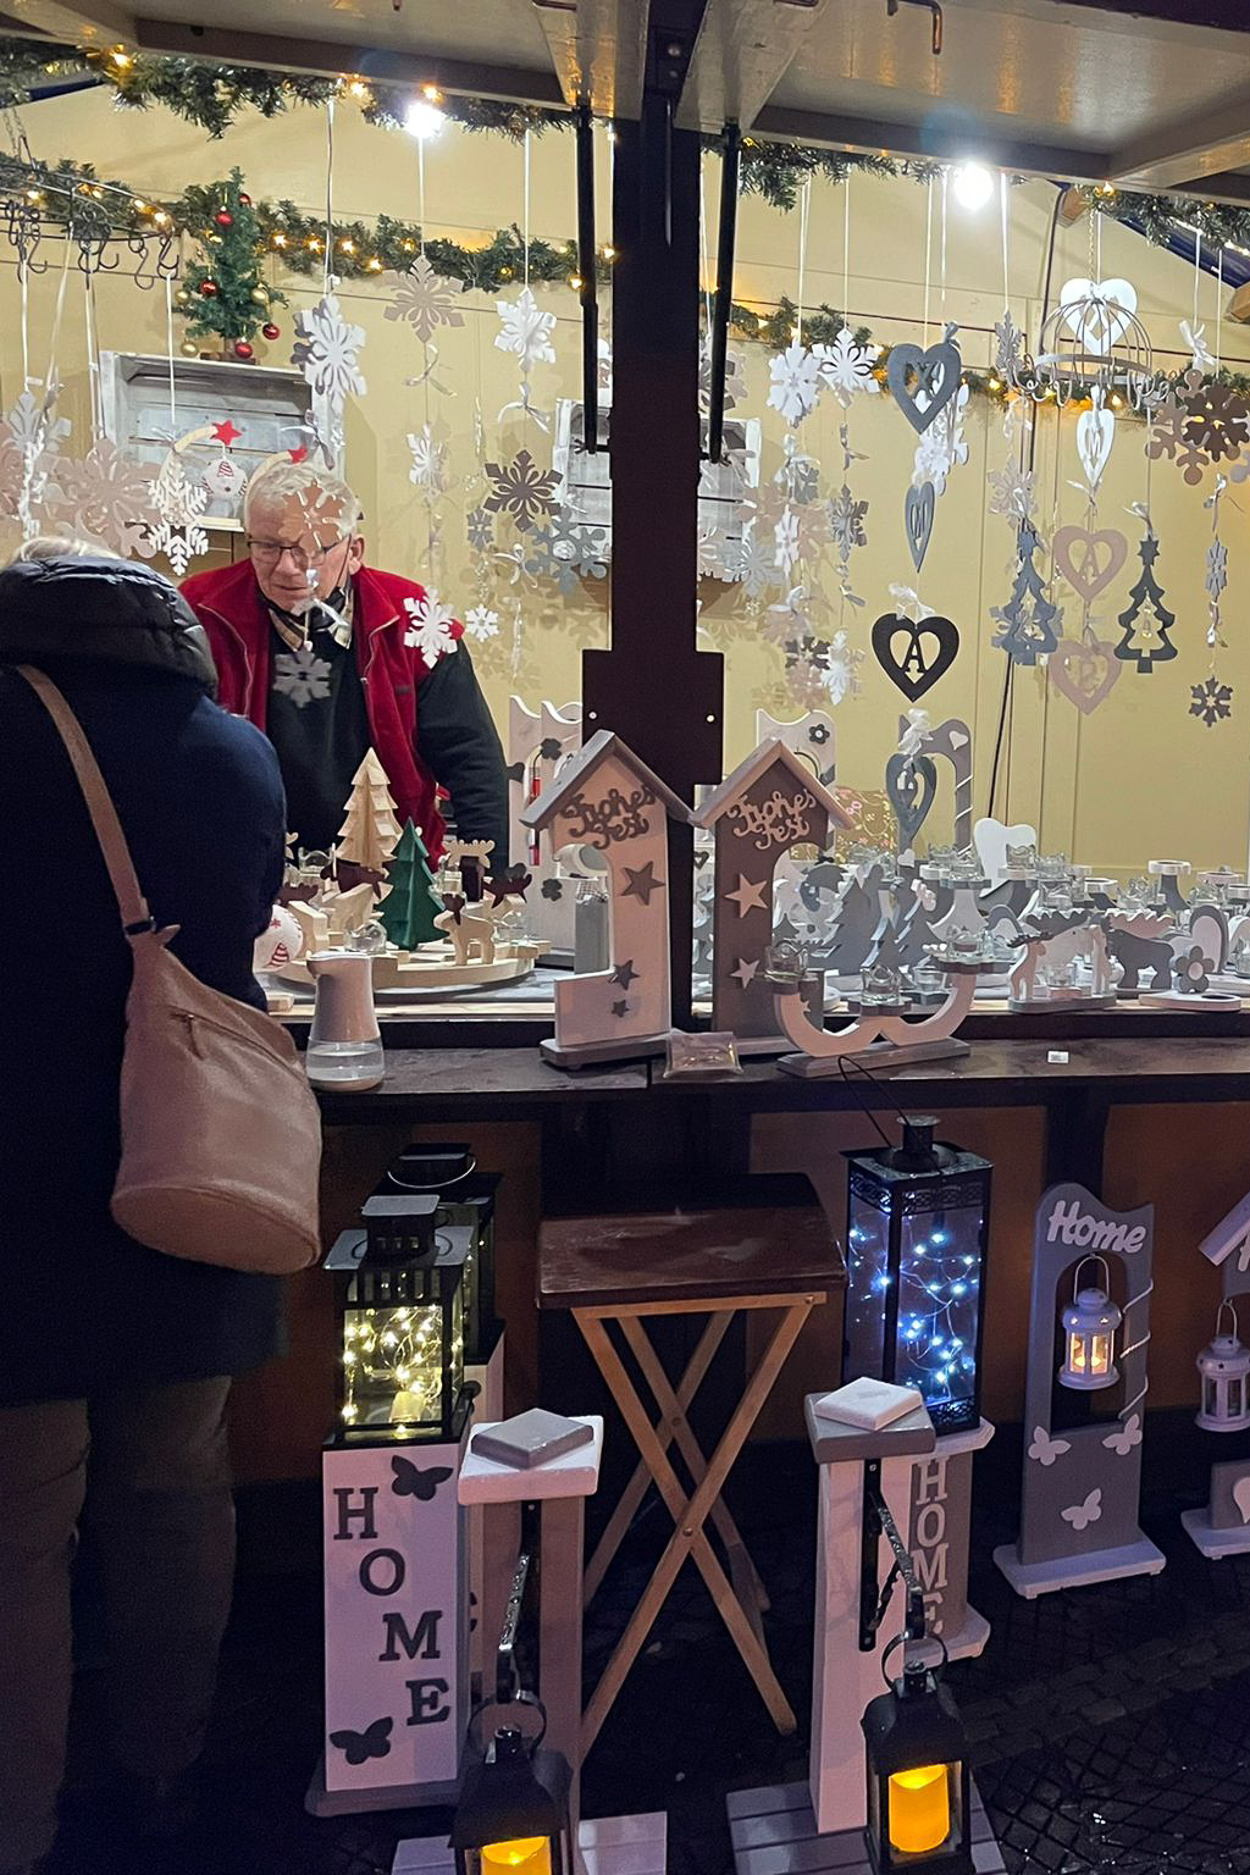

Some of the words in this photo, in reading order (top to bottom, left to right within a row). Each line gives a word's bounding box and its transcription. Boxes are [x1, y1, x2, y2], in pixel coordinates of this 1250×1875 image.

[727, 789, 817, 837] Frohes
[755, 815, 811, 850] Fest
[1046, 1199, 1147, 1254] Home
[332, 1486, 452, 1727] HOME
